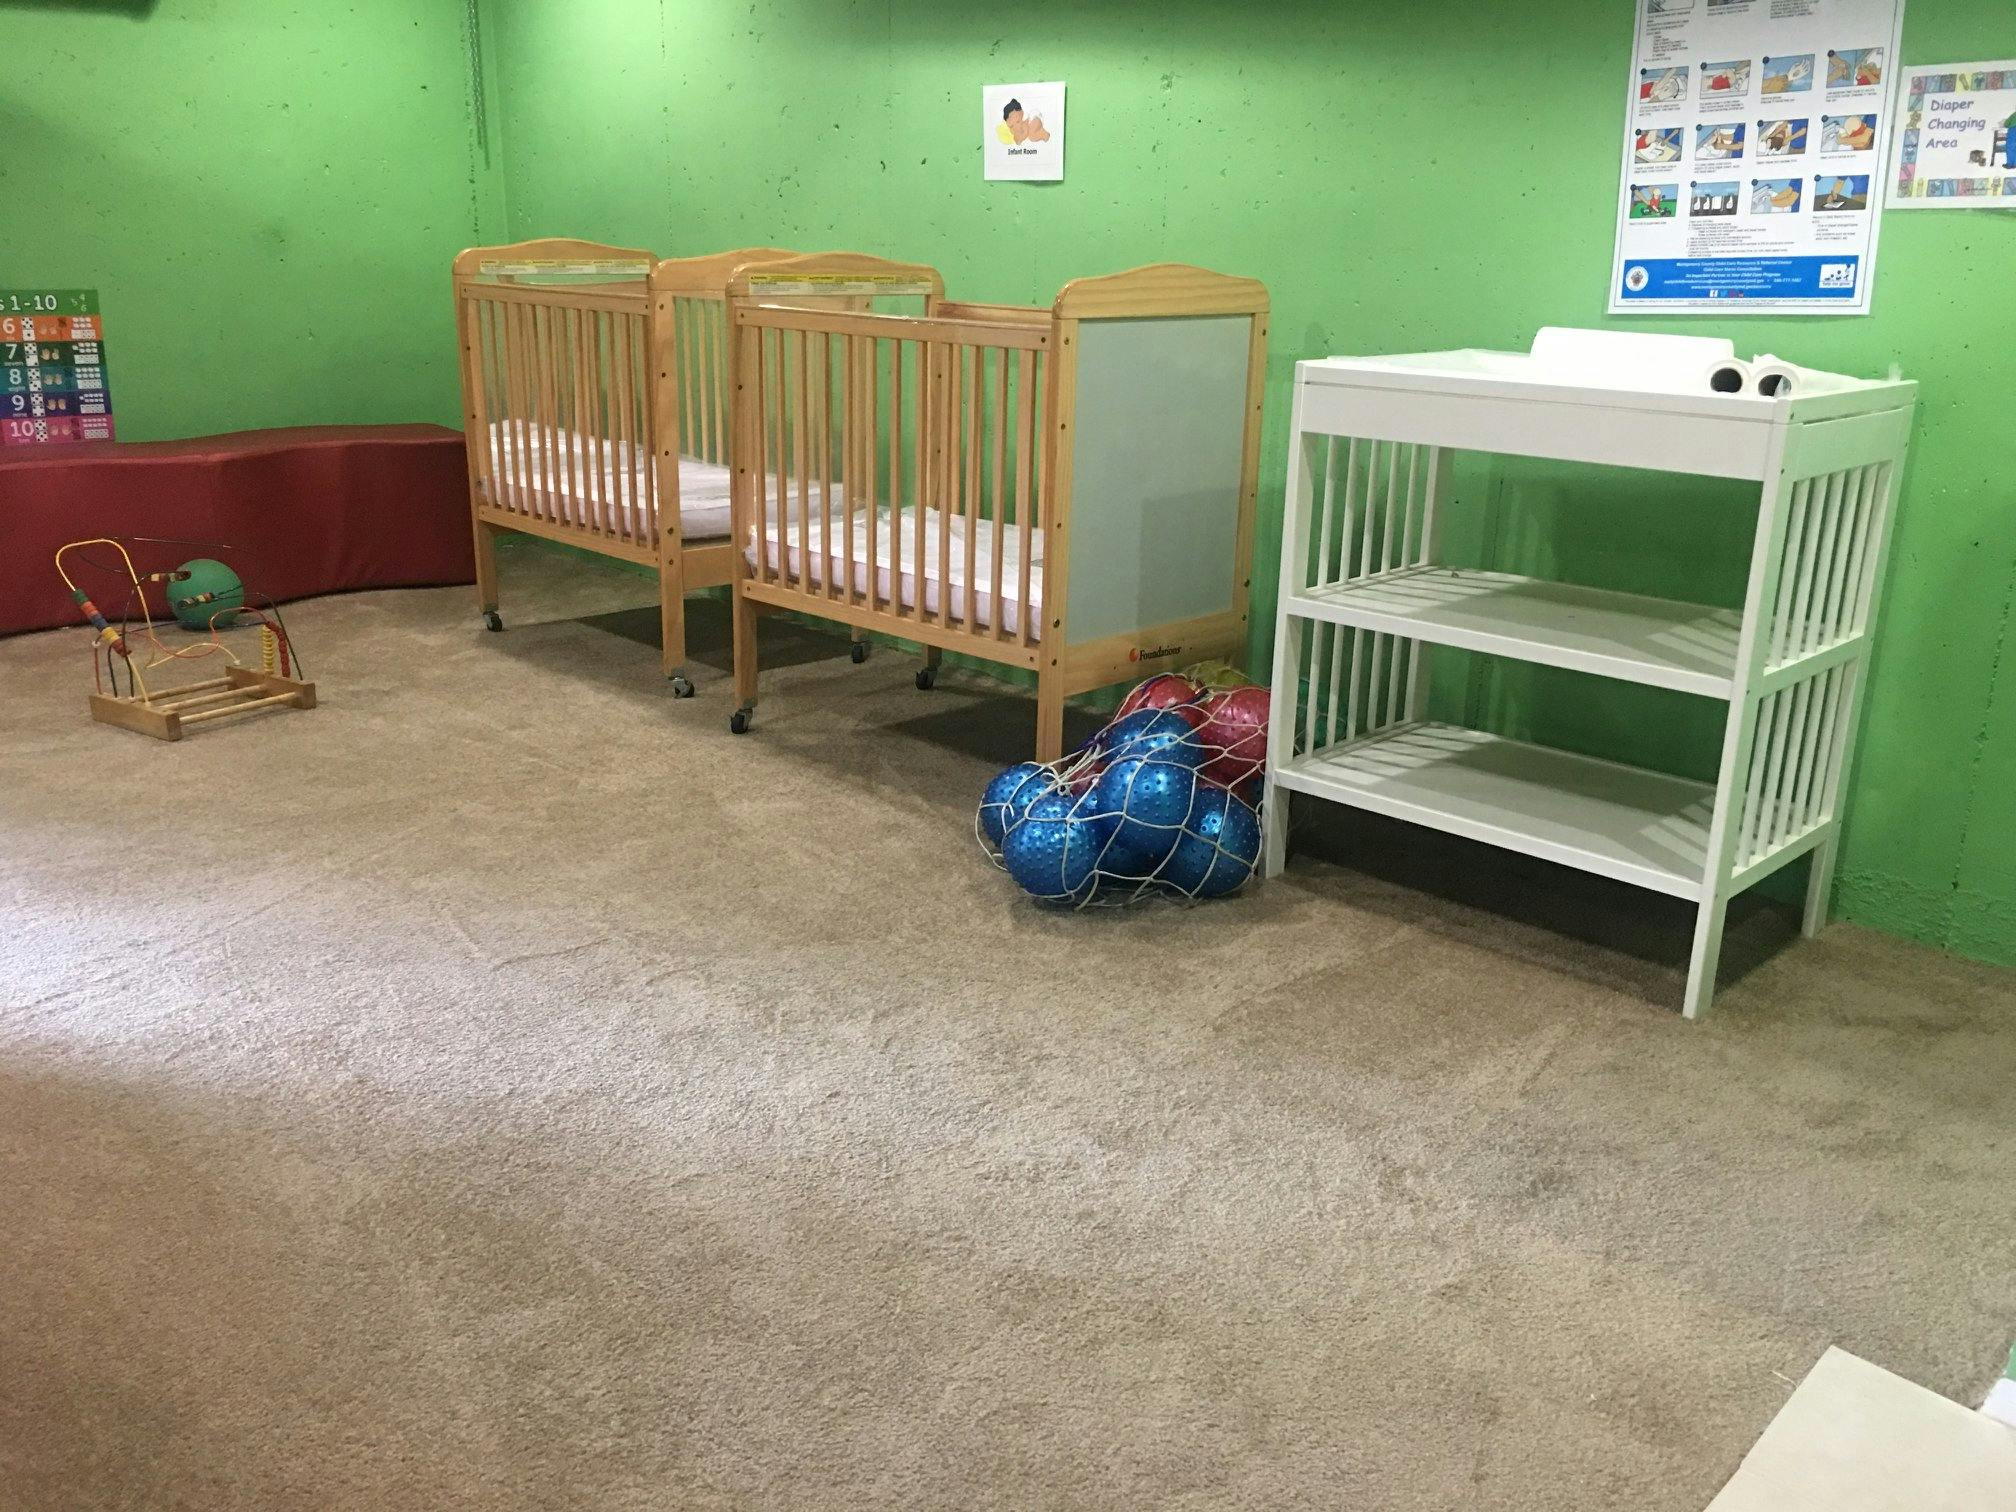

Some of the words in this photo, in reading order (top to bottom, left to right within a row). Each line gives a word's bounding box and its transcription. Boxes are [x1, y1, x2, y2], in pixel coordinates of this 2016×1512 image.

[1930, 99, 1974, 113] Diaper
[1927, 117, 1986, 132] Changing
[1925, 138, 1958, 148] Area
[1007, 148, 1023, 156] Infant
[2, 317, 16, 334] 6
[5, 343, 18, 360] 7
[9, 368, 22, 385] 8
[11, 394, 25, 412] 9
[10, 420, 35, 438] 10
[1139, 645, 1182, 661] Foundations
